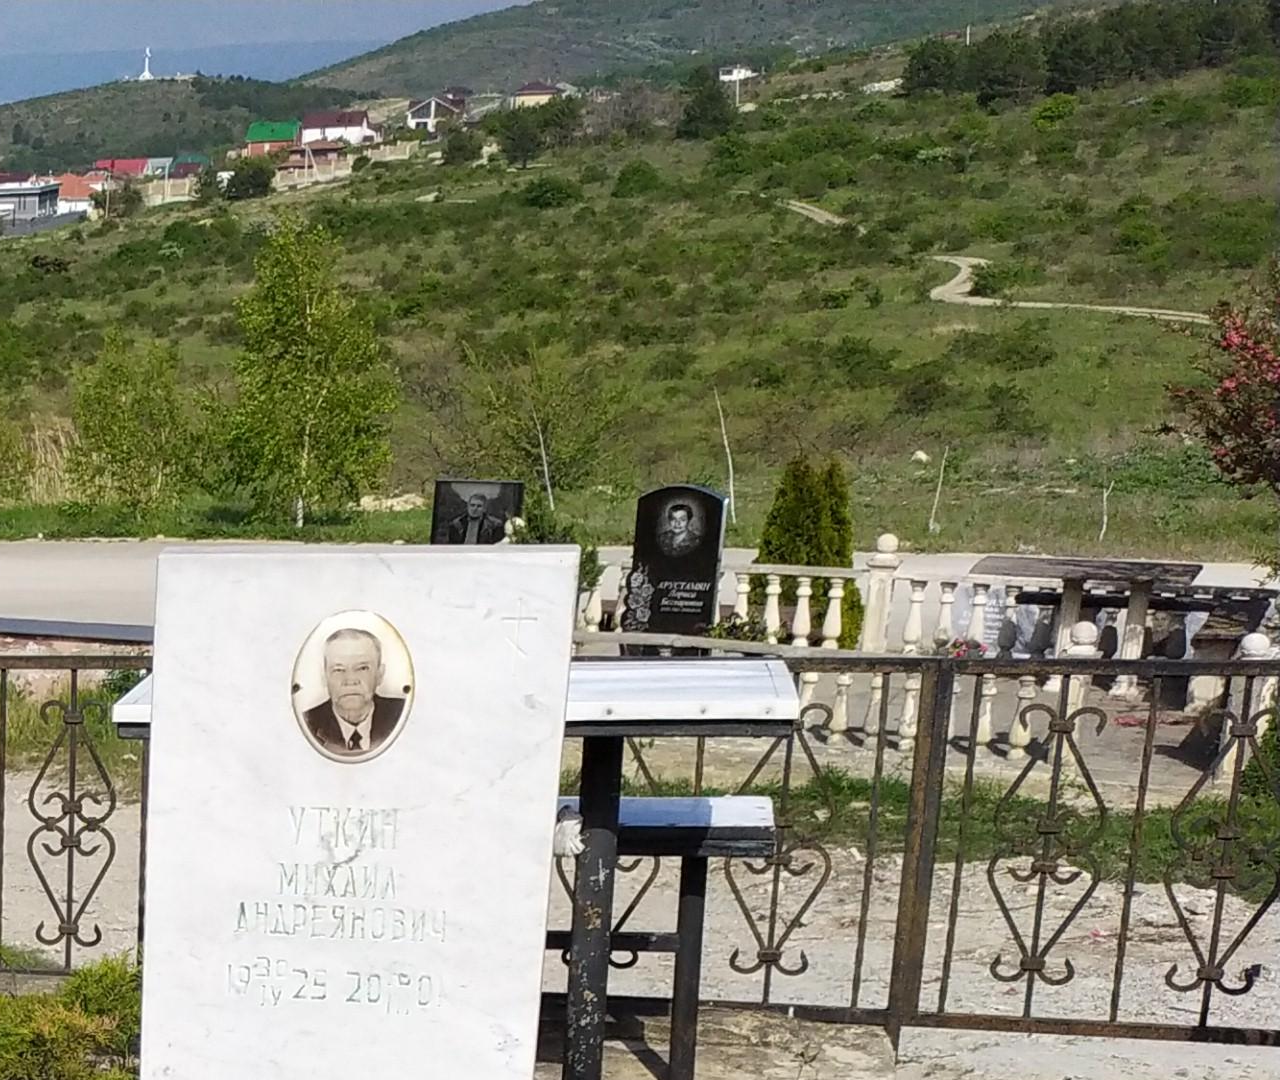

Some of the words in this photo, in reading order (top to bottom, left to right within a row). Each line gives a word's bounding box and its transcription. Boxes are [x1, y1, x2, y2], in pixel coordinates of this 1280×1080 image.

[288, 806, 401, 850] УТКИН
[278, 862, 398, 900] МИХАИЛ
[232, 901, 448, 943] АНДРЕЯНОВИЧ
